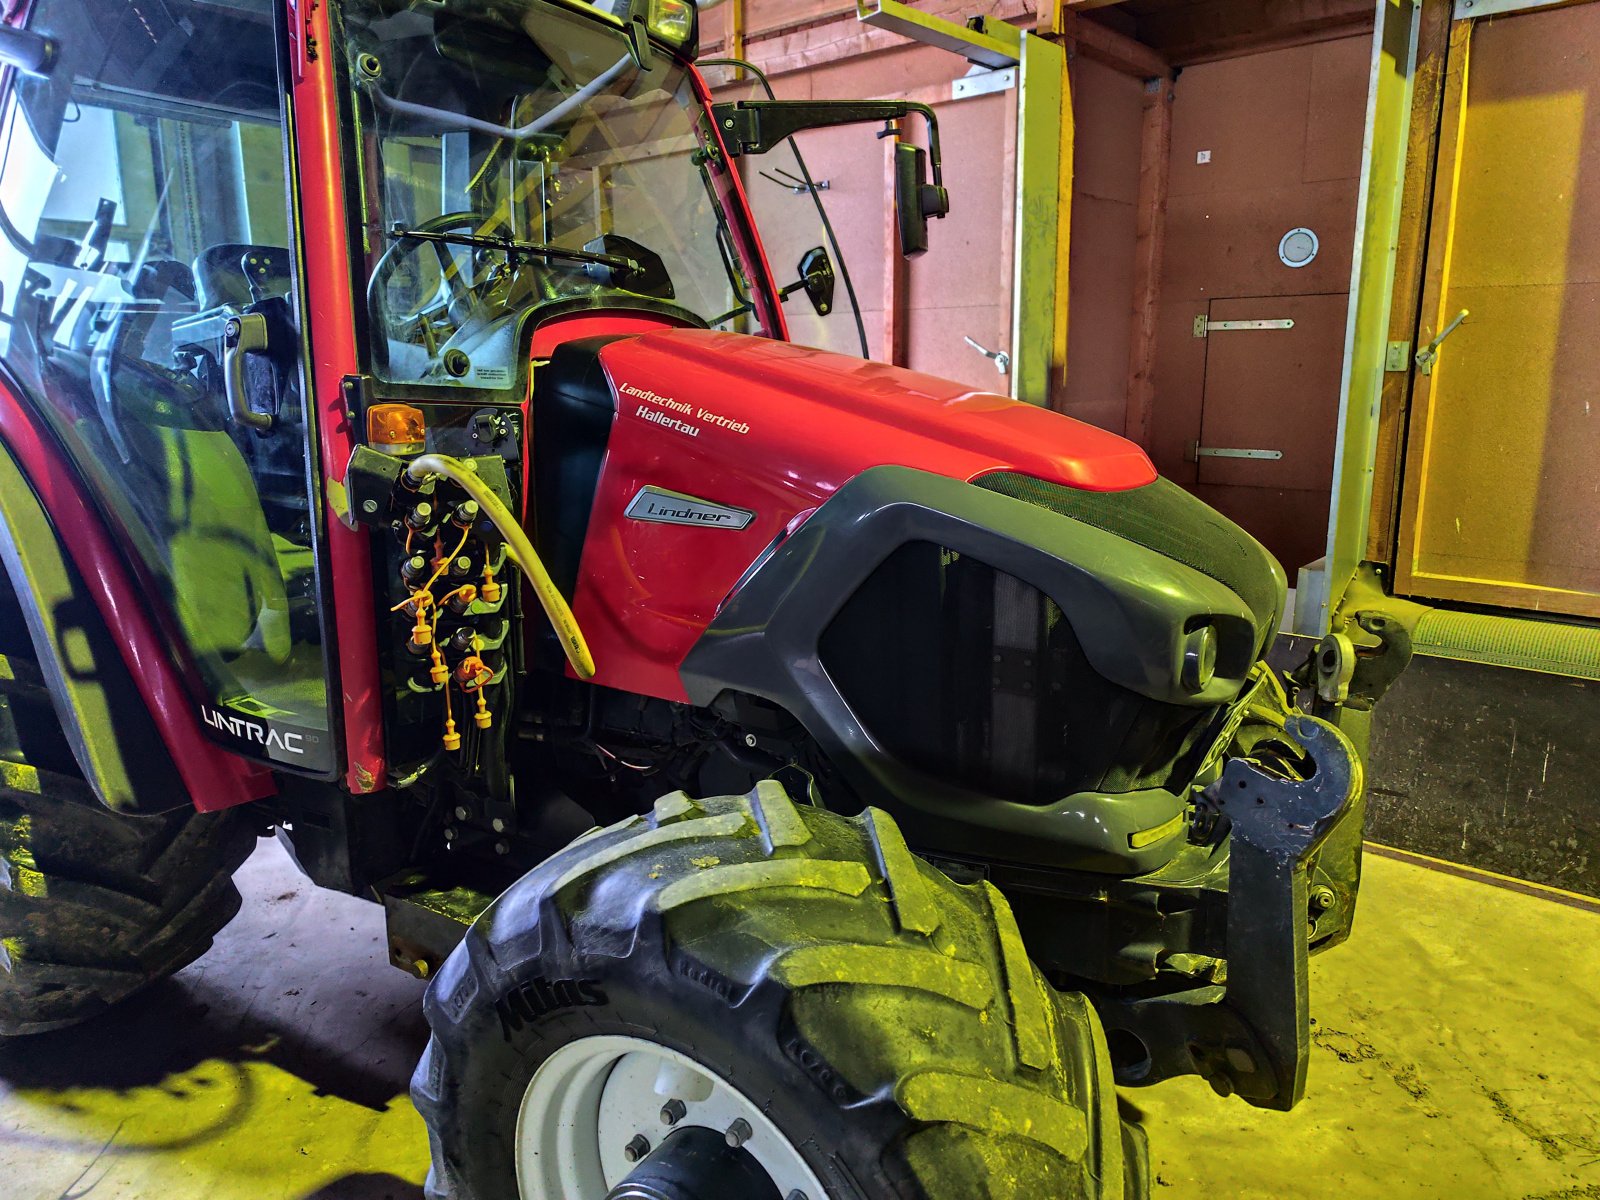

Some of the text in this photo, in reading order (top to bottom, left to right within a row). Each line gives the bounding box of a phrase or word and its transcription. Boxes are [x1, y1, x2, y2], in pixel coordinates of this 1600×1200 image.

[619, 382, 750, 434] Landtechnik Vertrieb
[635, 405, 700, 437] Hallertau
[647, 502, 732, 522] Lindner
[201, 704, 304, 754] LINTRAC
[495, 975, 609, 1043] Mitas
